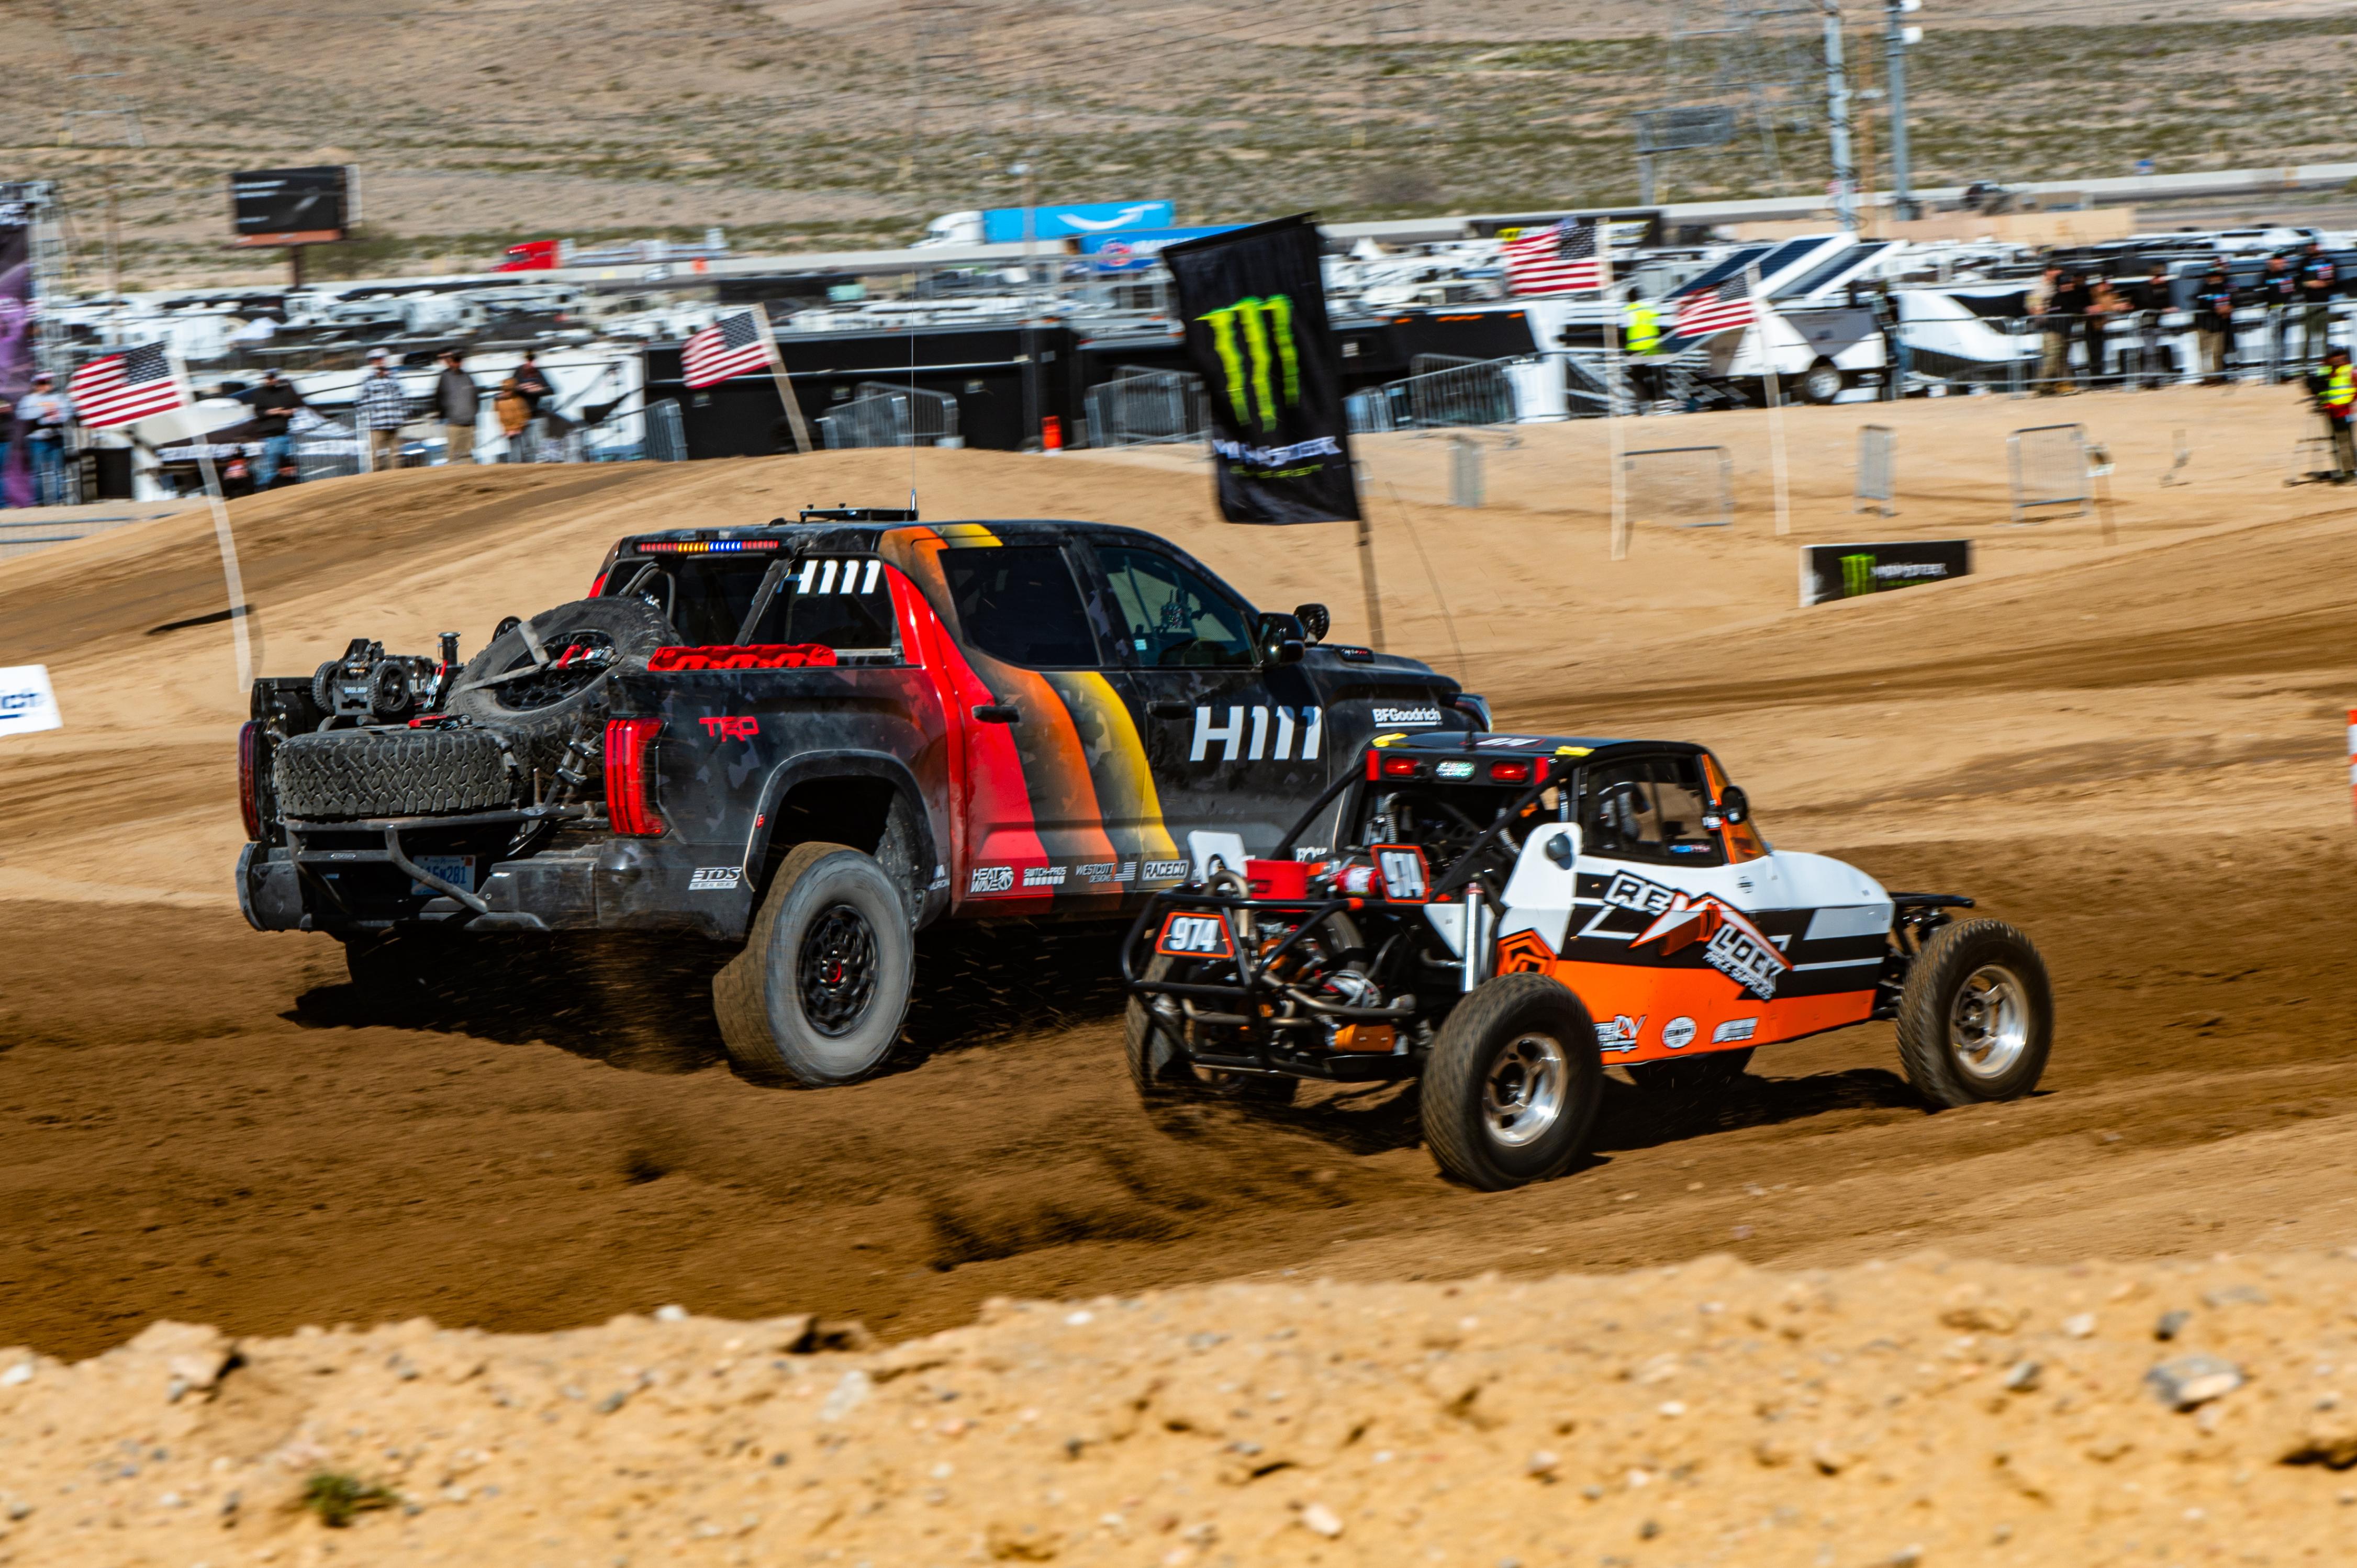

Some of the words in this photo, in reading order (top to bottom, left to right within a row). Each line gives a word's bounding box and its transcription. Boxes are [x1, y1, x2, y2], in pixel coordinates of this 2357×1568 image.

[1372, 708, 1442, 722] BFGoodrich
[699, 716, 759, 742] TRD
[692, 867, 743, 882] TDS
[973, 867, 1002, 880] HEAT
[1024, 866, 1067, 877] SWITCH-PROS
[1075, 863, 1116, 876] WESTCOTT
[1144, 861, 1186, 878] RACECO
[1169, 917, 1219, 951] 974
